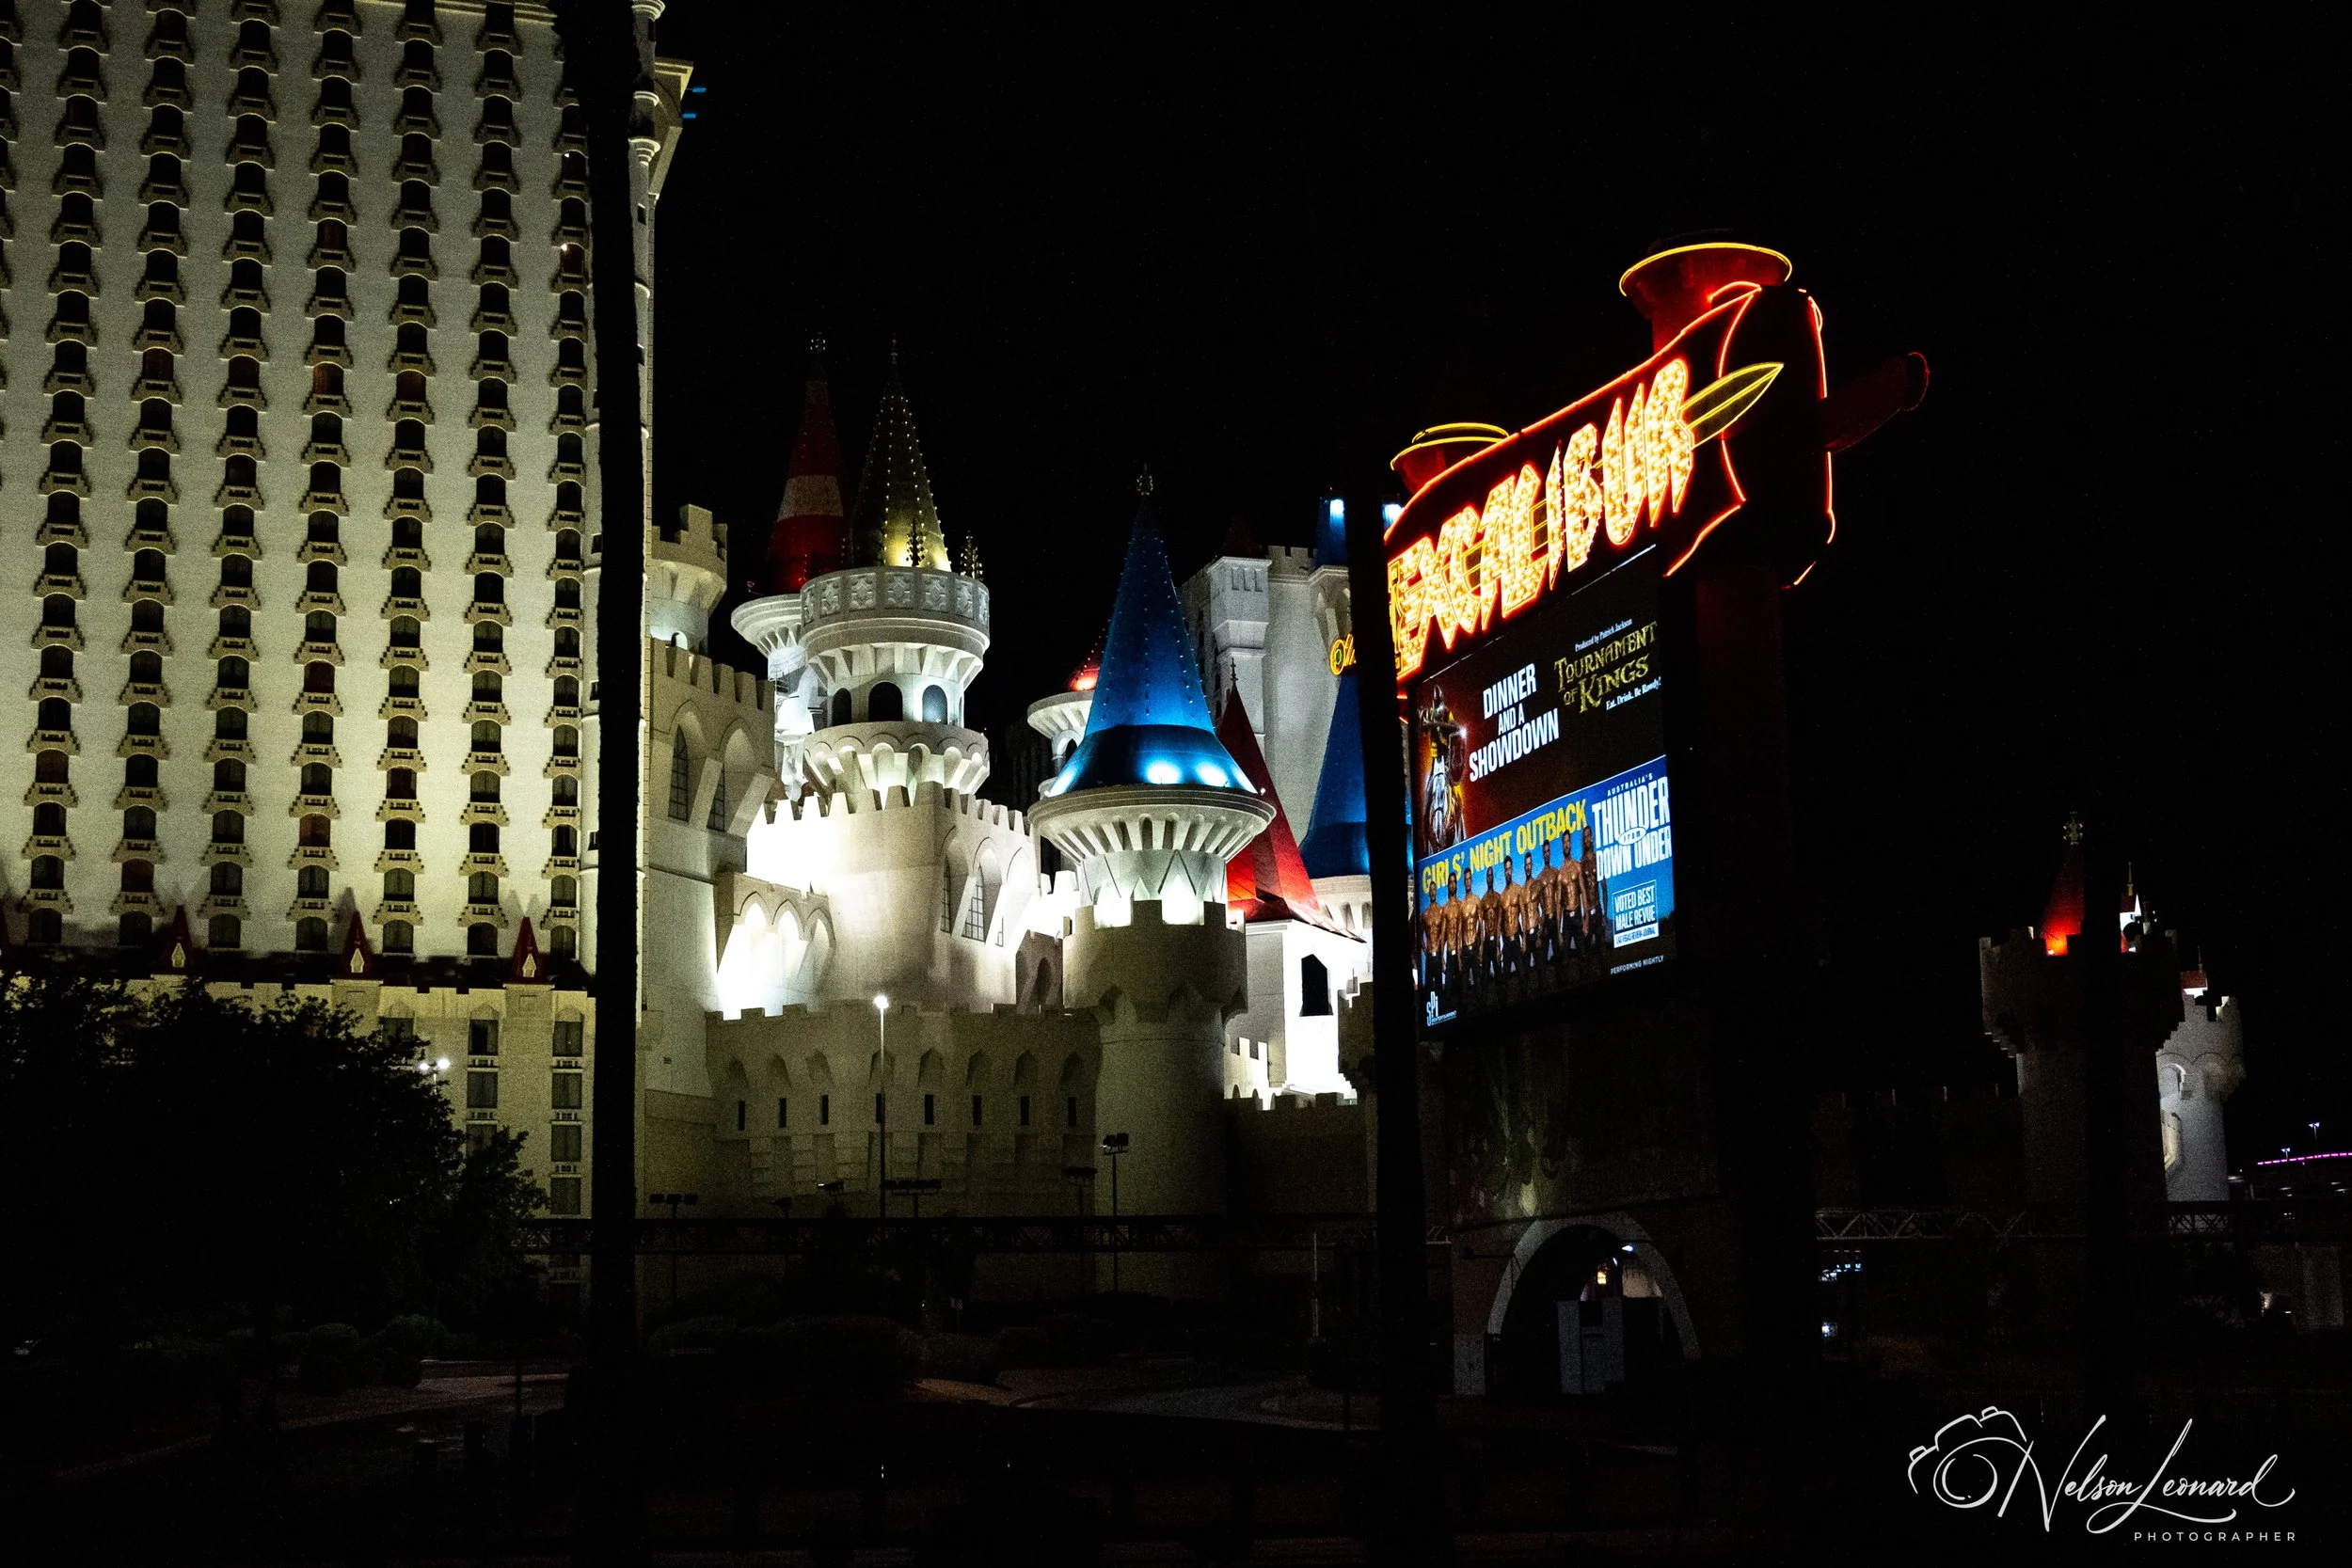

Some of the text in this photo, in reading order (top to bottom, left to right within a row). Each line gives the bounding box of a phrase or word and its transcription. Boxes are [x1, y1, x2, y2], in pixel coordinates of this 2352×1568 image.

[1387, 357, 1695, 681] EXCALIBUR
[1554, 621, 1658, 692] TOURNAMENT
[1564, 653, 1649, 713] OF KINGS
[1483, 663, 1537, 720] DINNER
[1498, 702, 1525, 736] AND A
[1469, 707, 1560, 783] SHOWDOWN
[1591, 776, 1671, 849] THUNDER
[1607, 772, 1653, 797] AUSTRALIA'S
[1470, 831, 1513, 875] NIGHT
[1516, 799, 1588, 855] OUTBACK
[1596, 825, 1673, 882] DOWN UNDER
[1614, 884, 1655, 913] VOTED BEST
[1615, 904, 1656, 932] MALE REVUE
[1610, 955, 1664, 975] PERFORMING NIGHTLY
